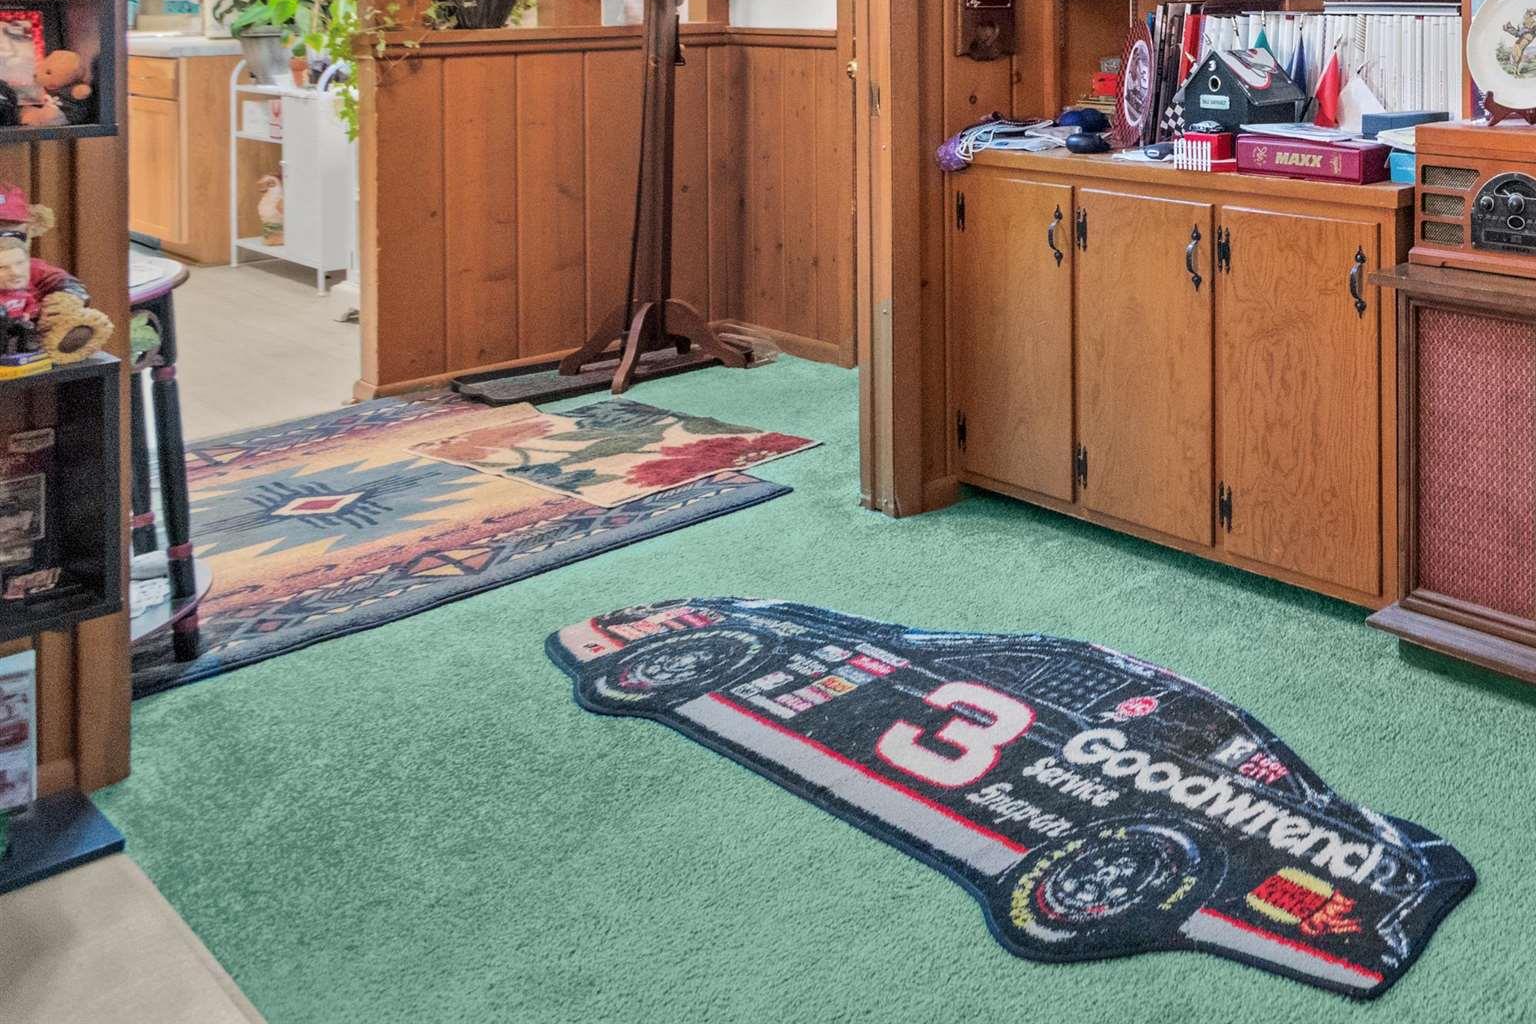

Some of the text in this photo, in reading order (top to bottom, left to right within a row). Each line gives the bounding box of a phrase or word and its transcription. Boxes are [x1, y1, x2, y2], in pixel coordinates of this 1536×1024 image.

[1207, 59, 1217, 71] 3
[1275, 151, 1323, 168] MAXX
[875, 680, 1037, 789] 3
[1022, 756, 1120, 807] Service
